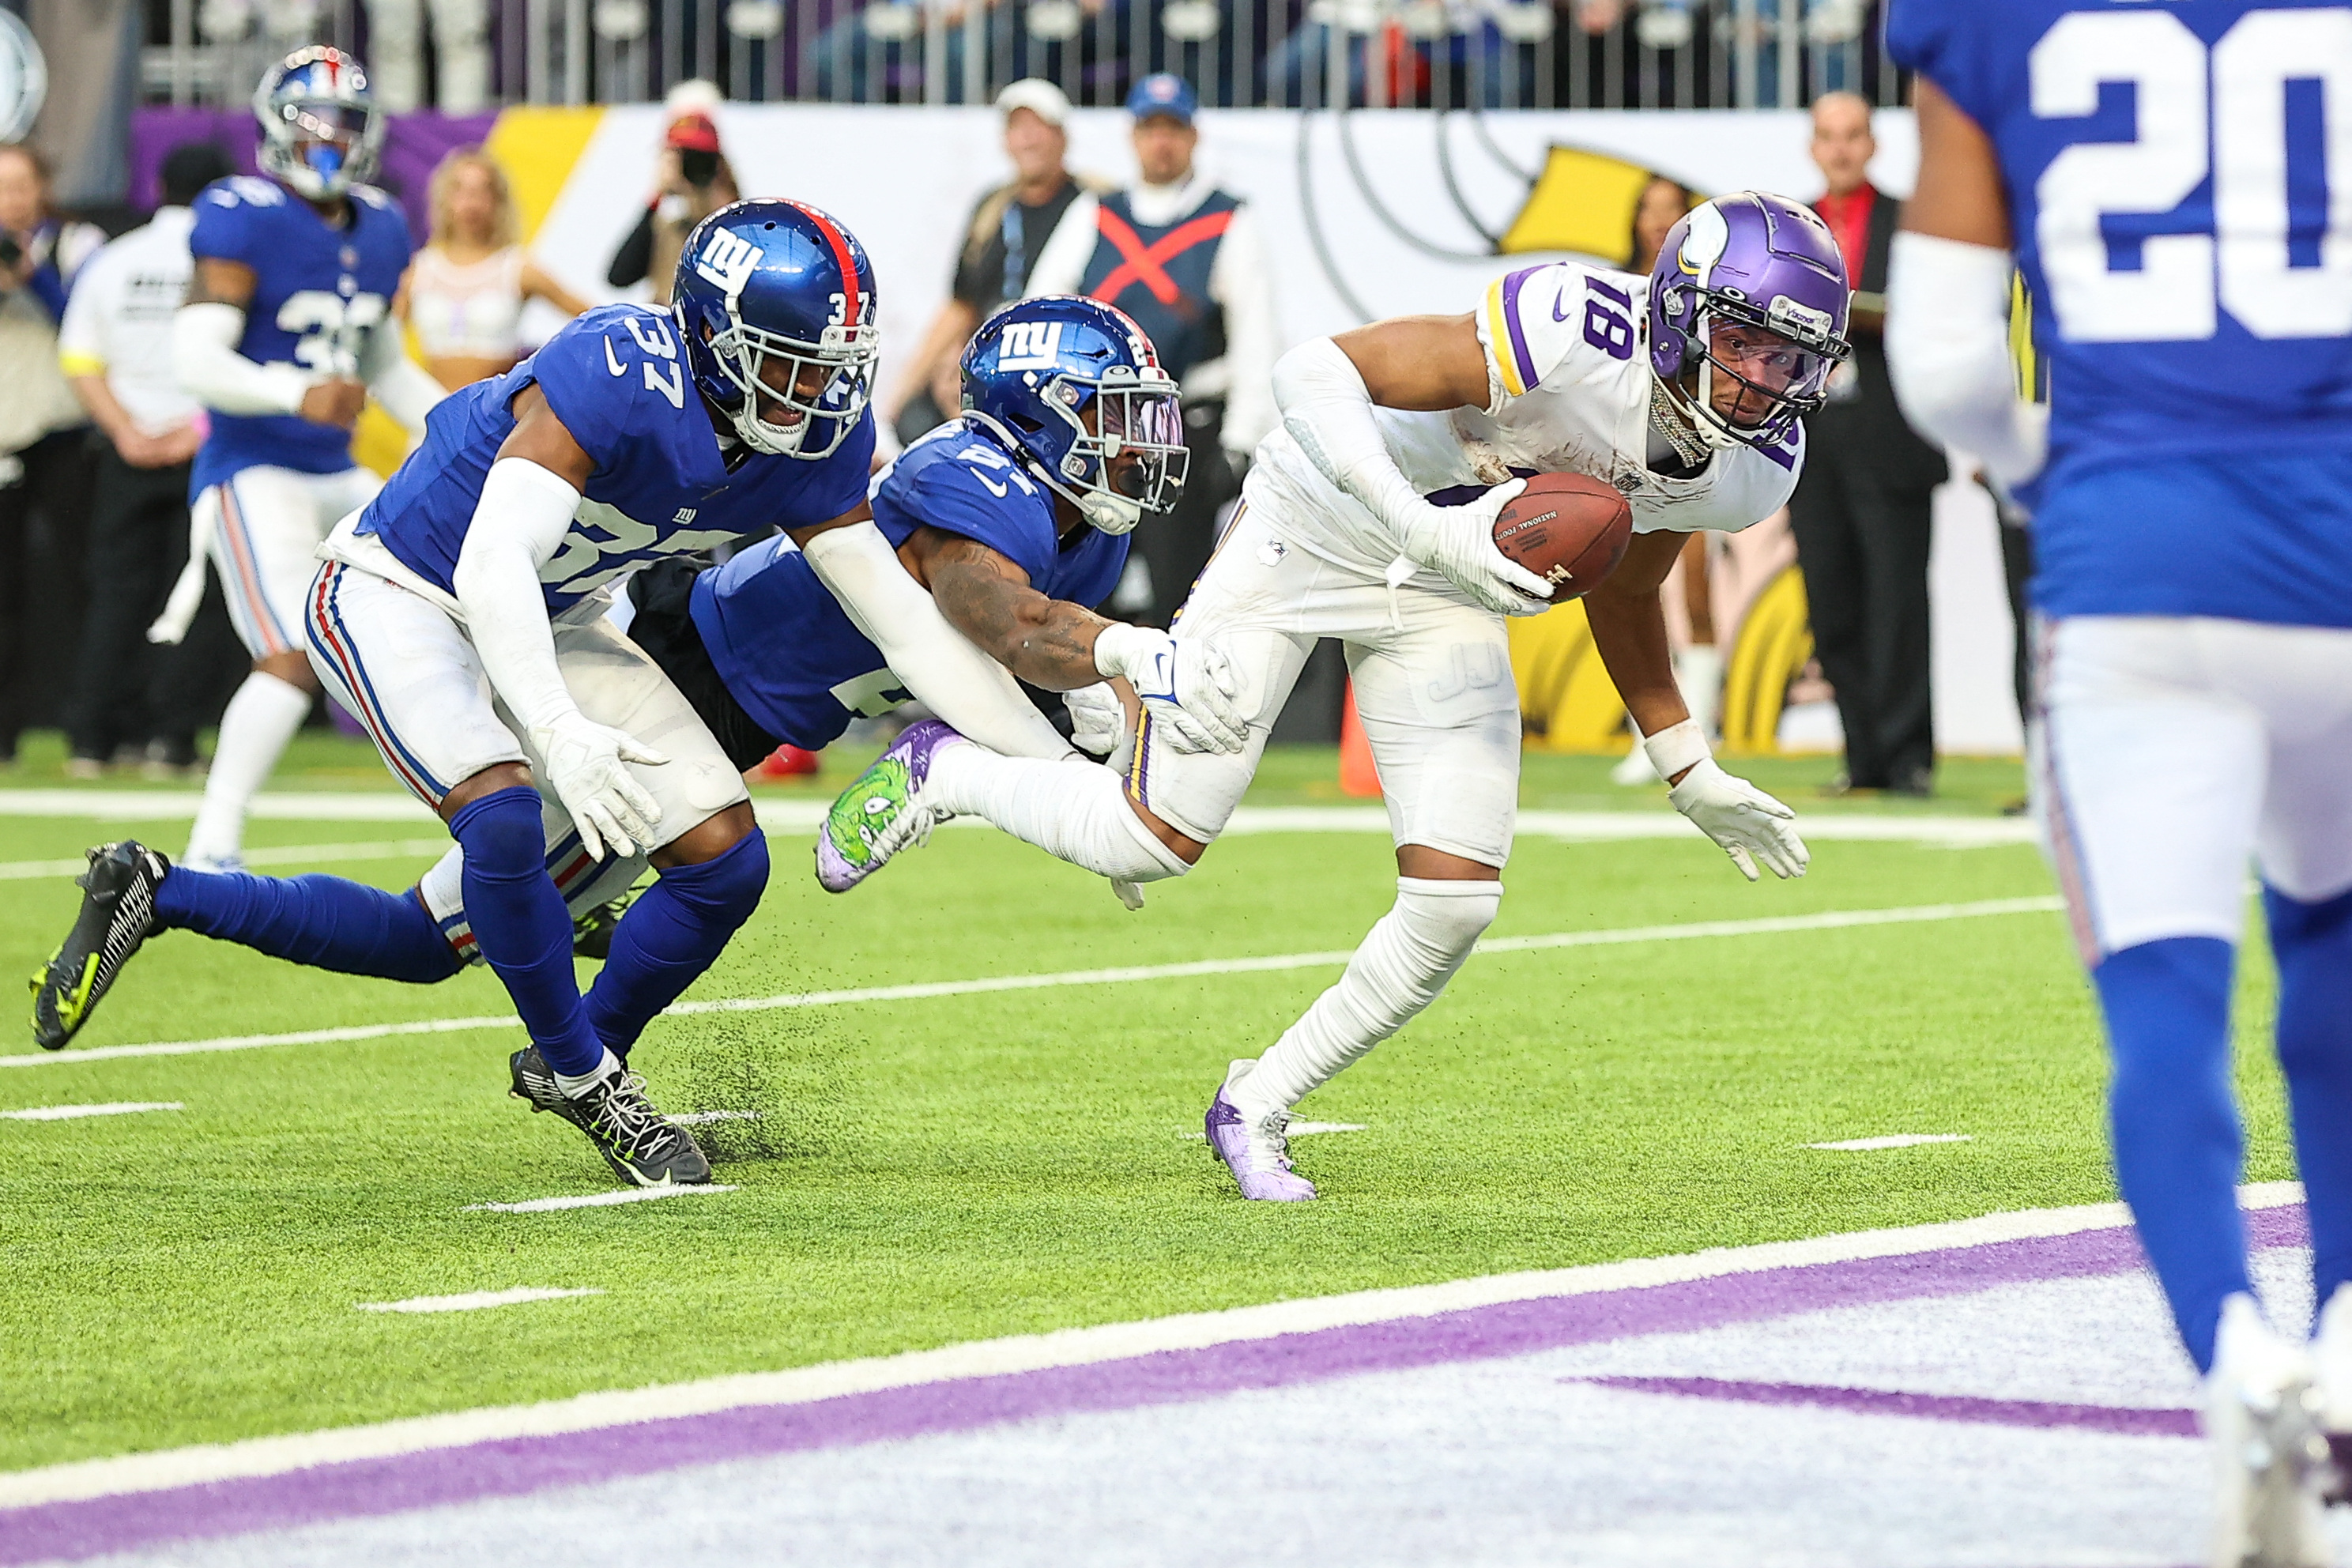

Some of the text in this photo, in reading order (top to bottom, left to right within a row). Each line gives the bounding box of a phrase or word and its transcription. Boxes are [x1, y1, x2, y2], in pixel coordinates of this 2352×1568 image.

[2026, 5, 2352, 345] 20
[828, 291, 870, 326] 37
[1583, 274, 1635, 361] 18
[624, 316, 684, 409] 37
[1517, 510, 1559, 530] NATIONAL
